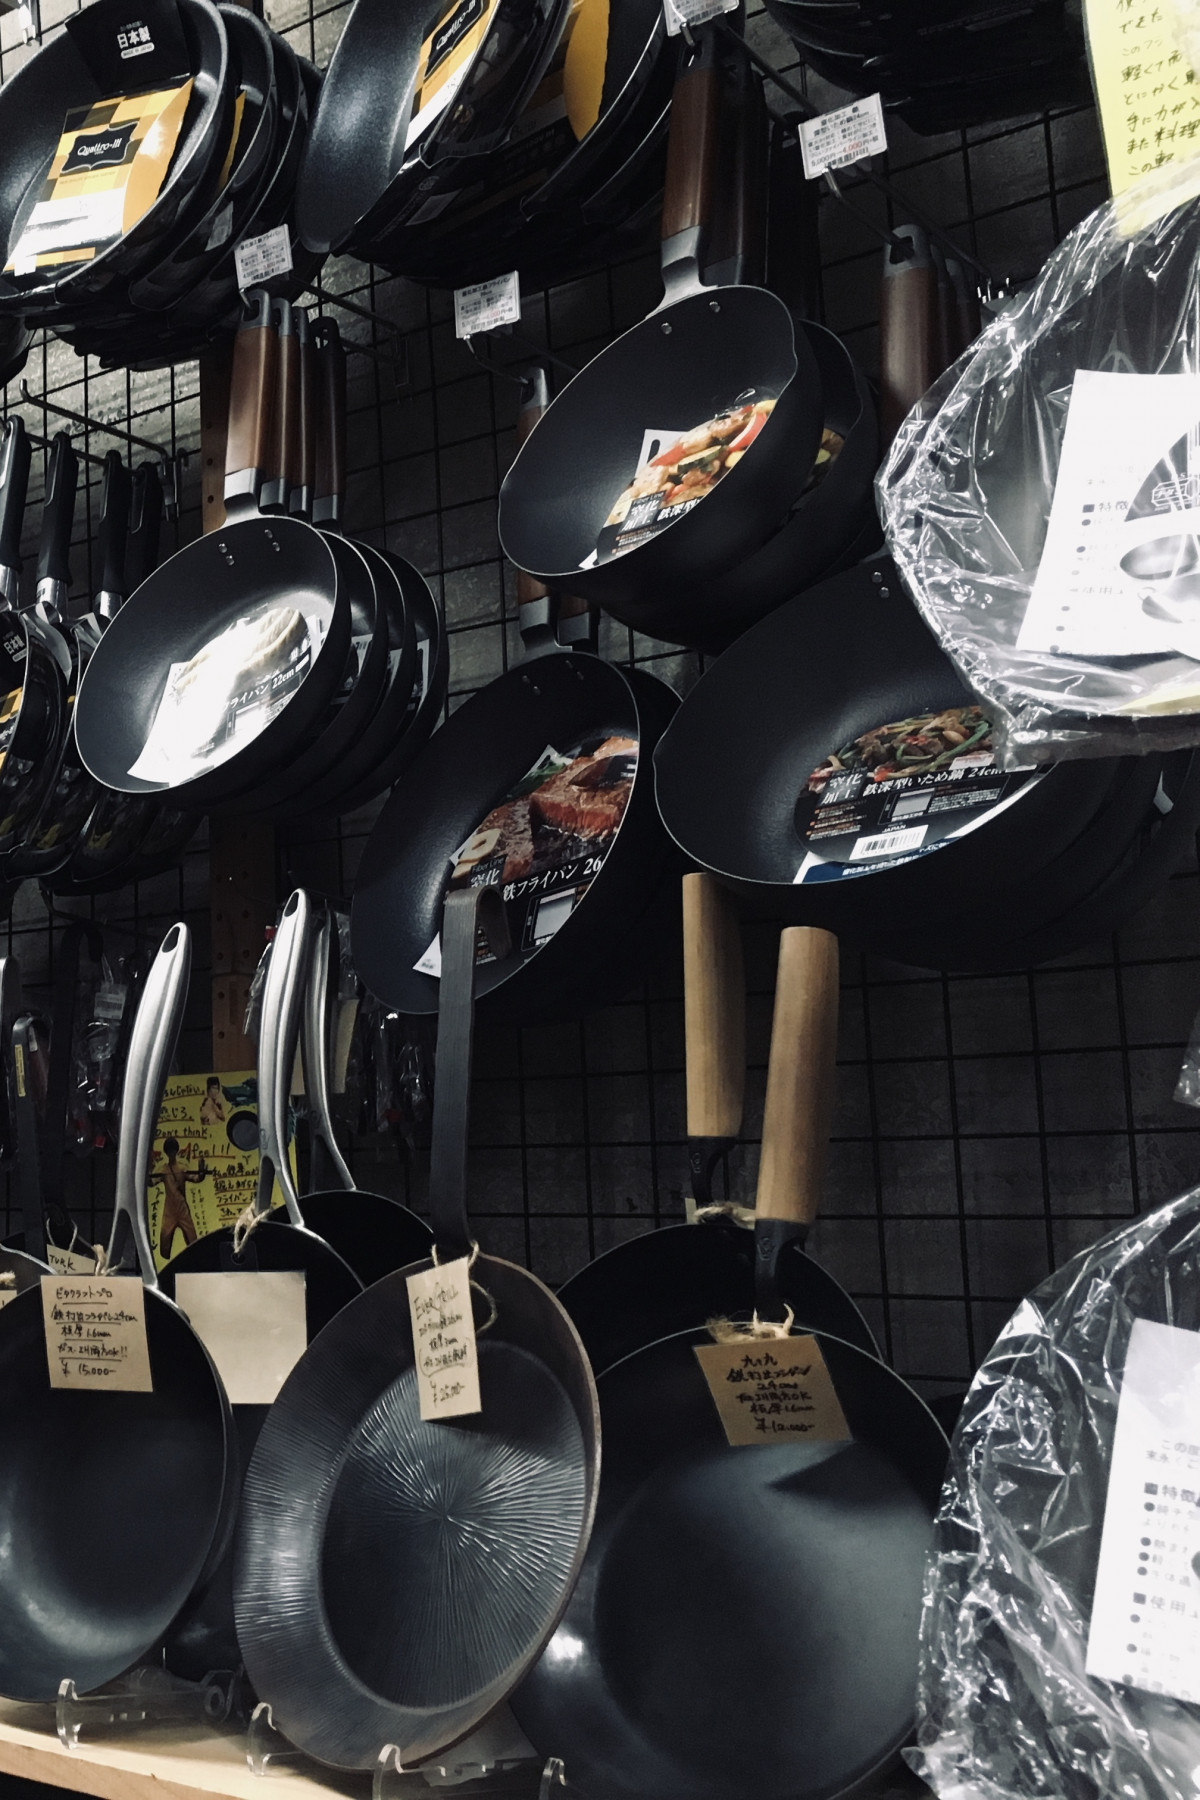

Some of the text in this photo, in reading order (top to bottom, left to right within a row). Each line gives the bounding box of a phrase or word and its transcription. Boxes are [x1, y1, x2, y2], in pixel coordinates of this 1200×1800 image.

[117, 26, 151, 49] 日本製
[3, 634, 25, 655] 日本製
[272, 669, 294, 689] 22cm
[503, 864, 578, 901] 鉄フライパン
